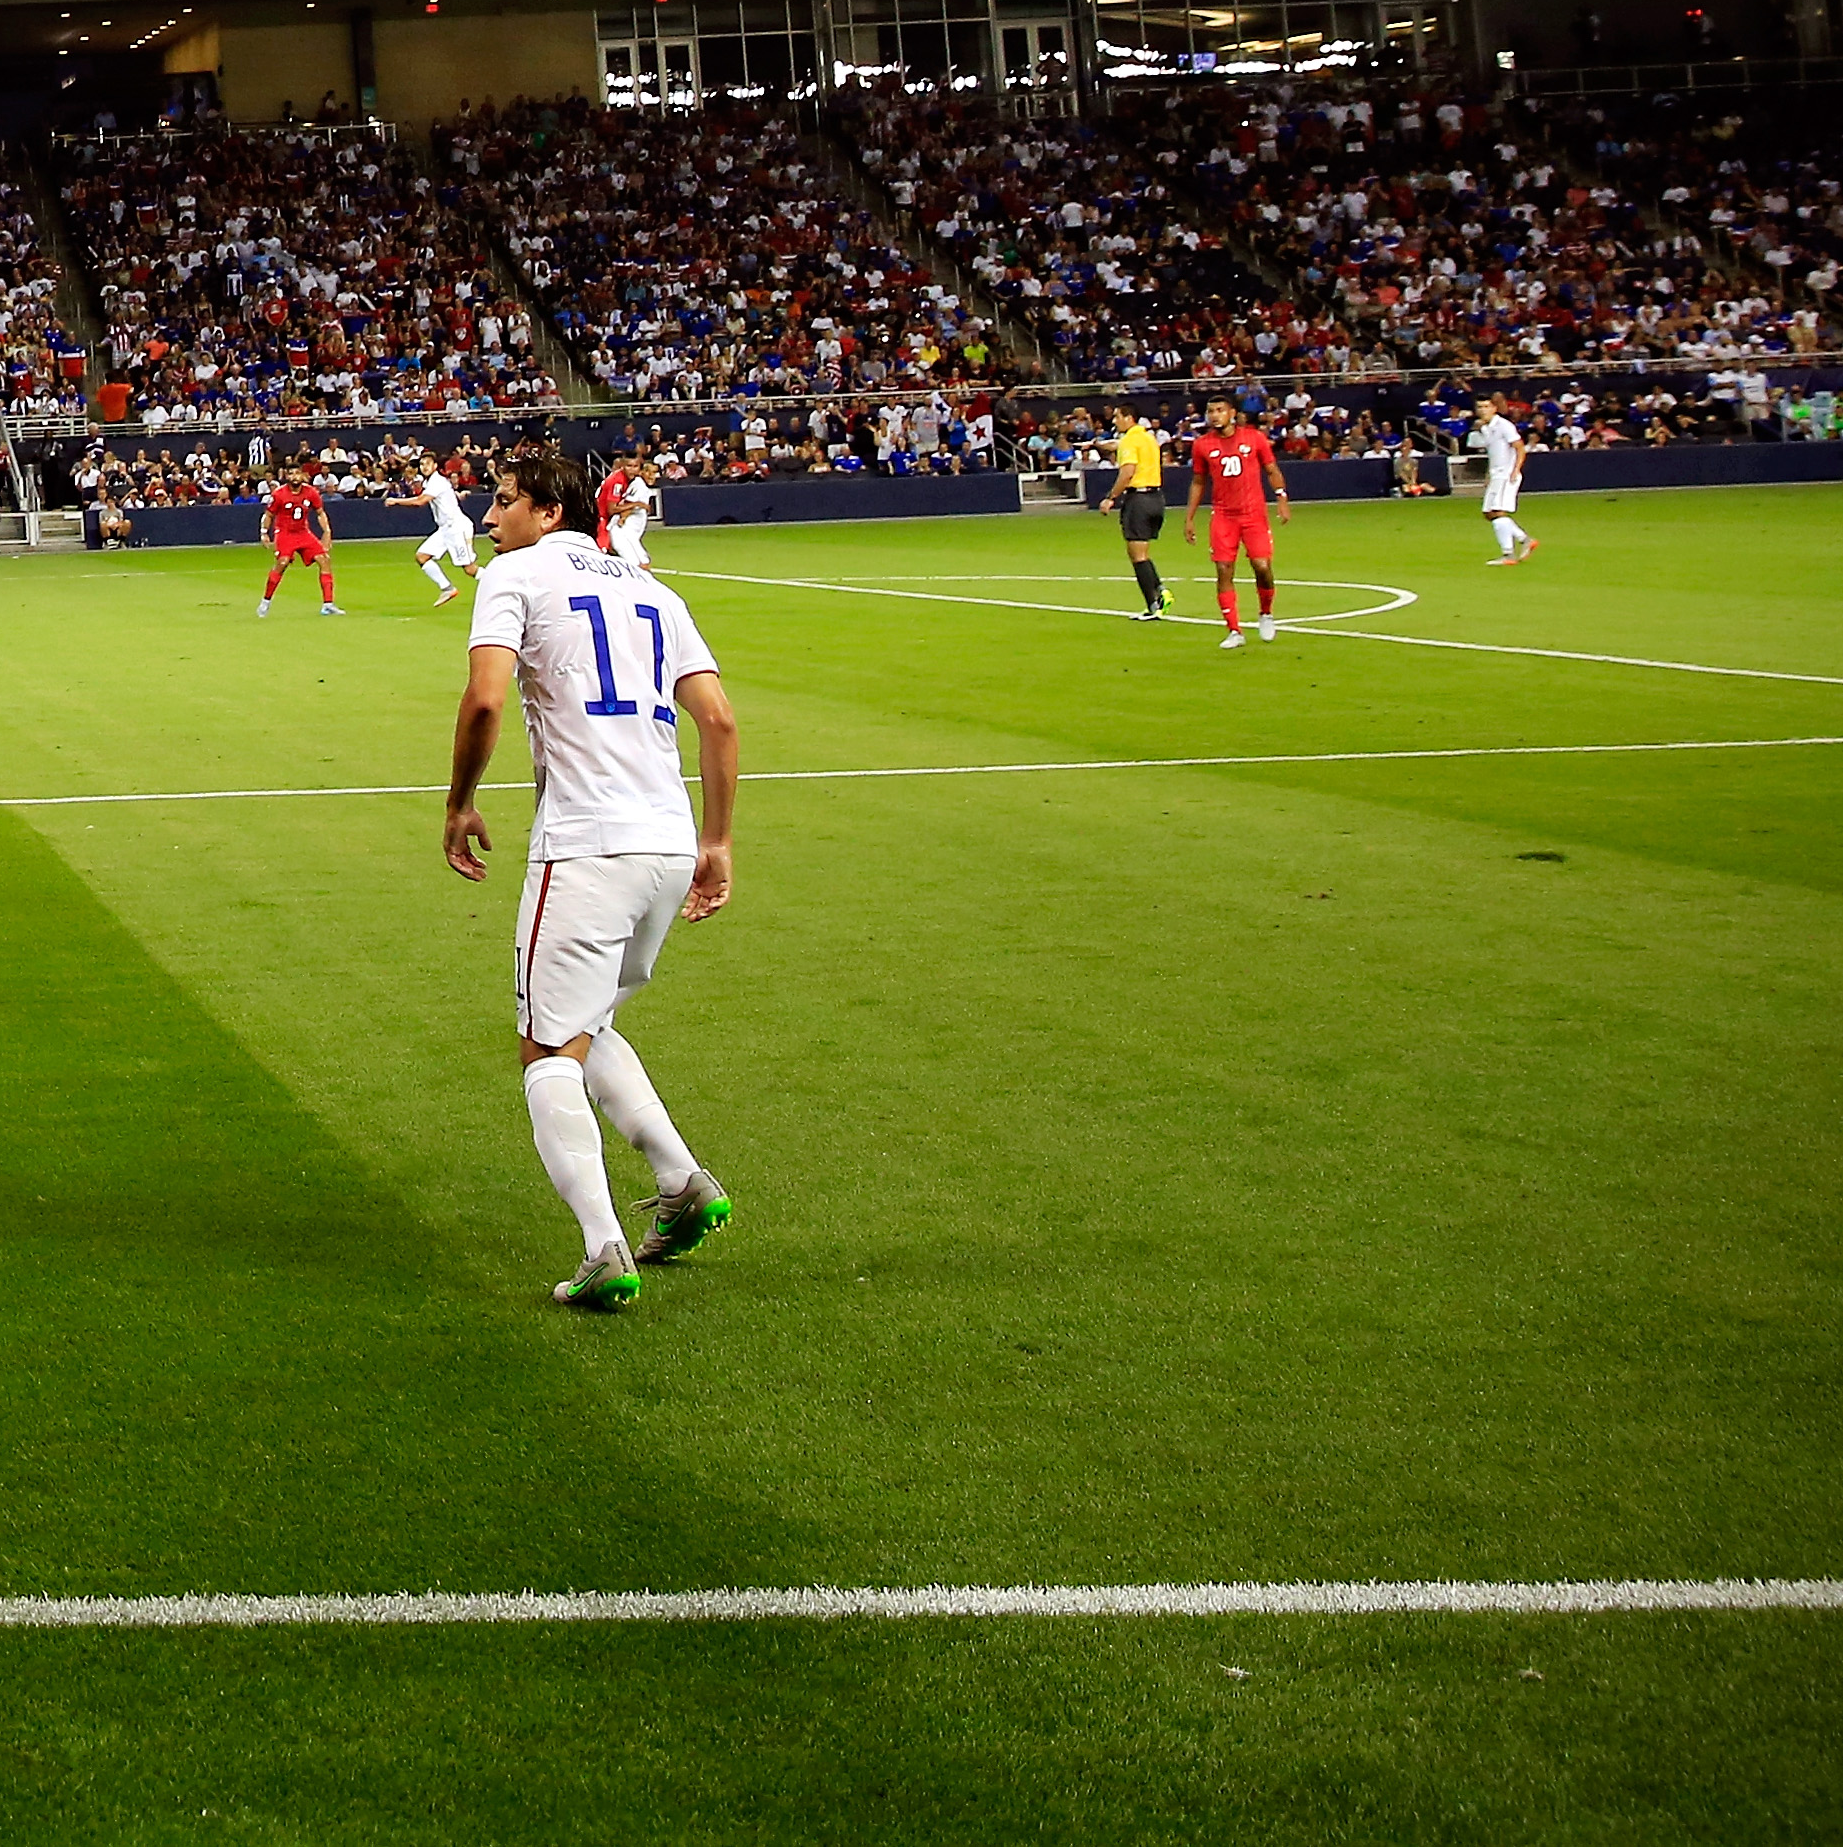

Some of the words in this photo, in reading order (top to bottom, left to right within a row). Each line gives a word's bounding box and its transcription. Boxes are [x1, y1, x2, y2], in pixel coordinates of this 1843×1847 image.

[1221, 456, 1242, 477] 20
[293, 507, 302, 520] 8
[567, 552, 648, 584] BEDOYA
[569, 595, 677, 728] 11
